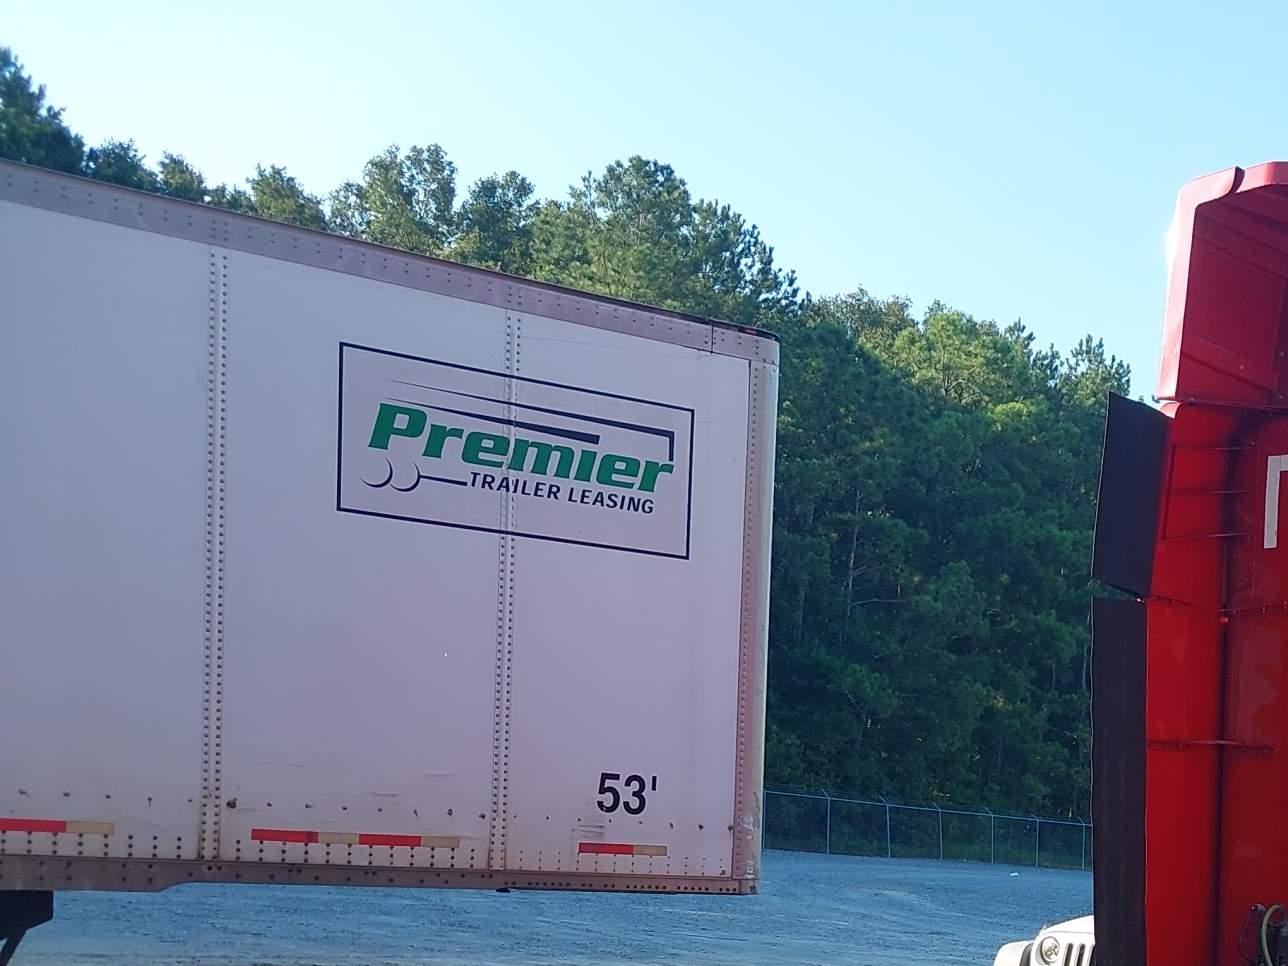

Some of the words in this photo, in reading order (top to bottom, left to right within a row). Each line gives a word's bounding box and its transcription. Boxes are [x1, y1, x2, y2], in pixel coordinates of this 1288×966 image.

[367, 401, 675, 493] Premier
[469, 471, 562, 501] TRAILER
[566, 486, 655, 515] LEASING
[596, 772, 659, 816] 53'
